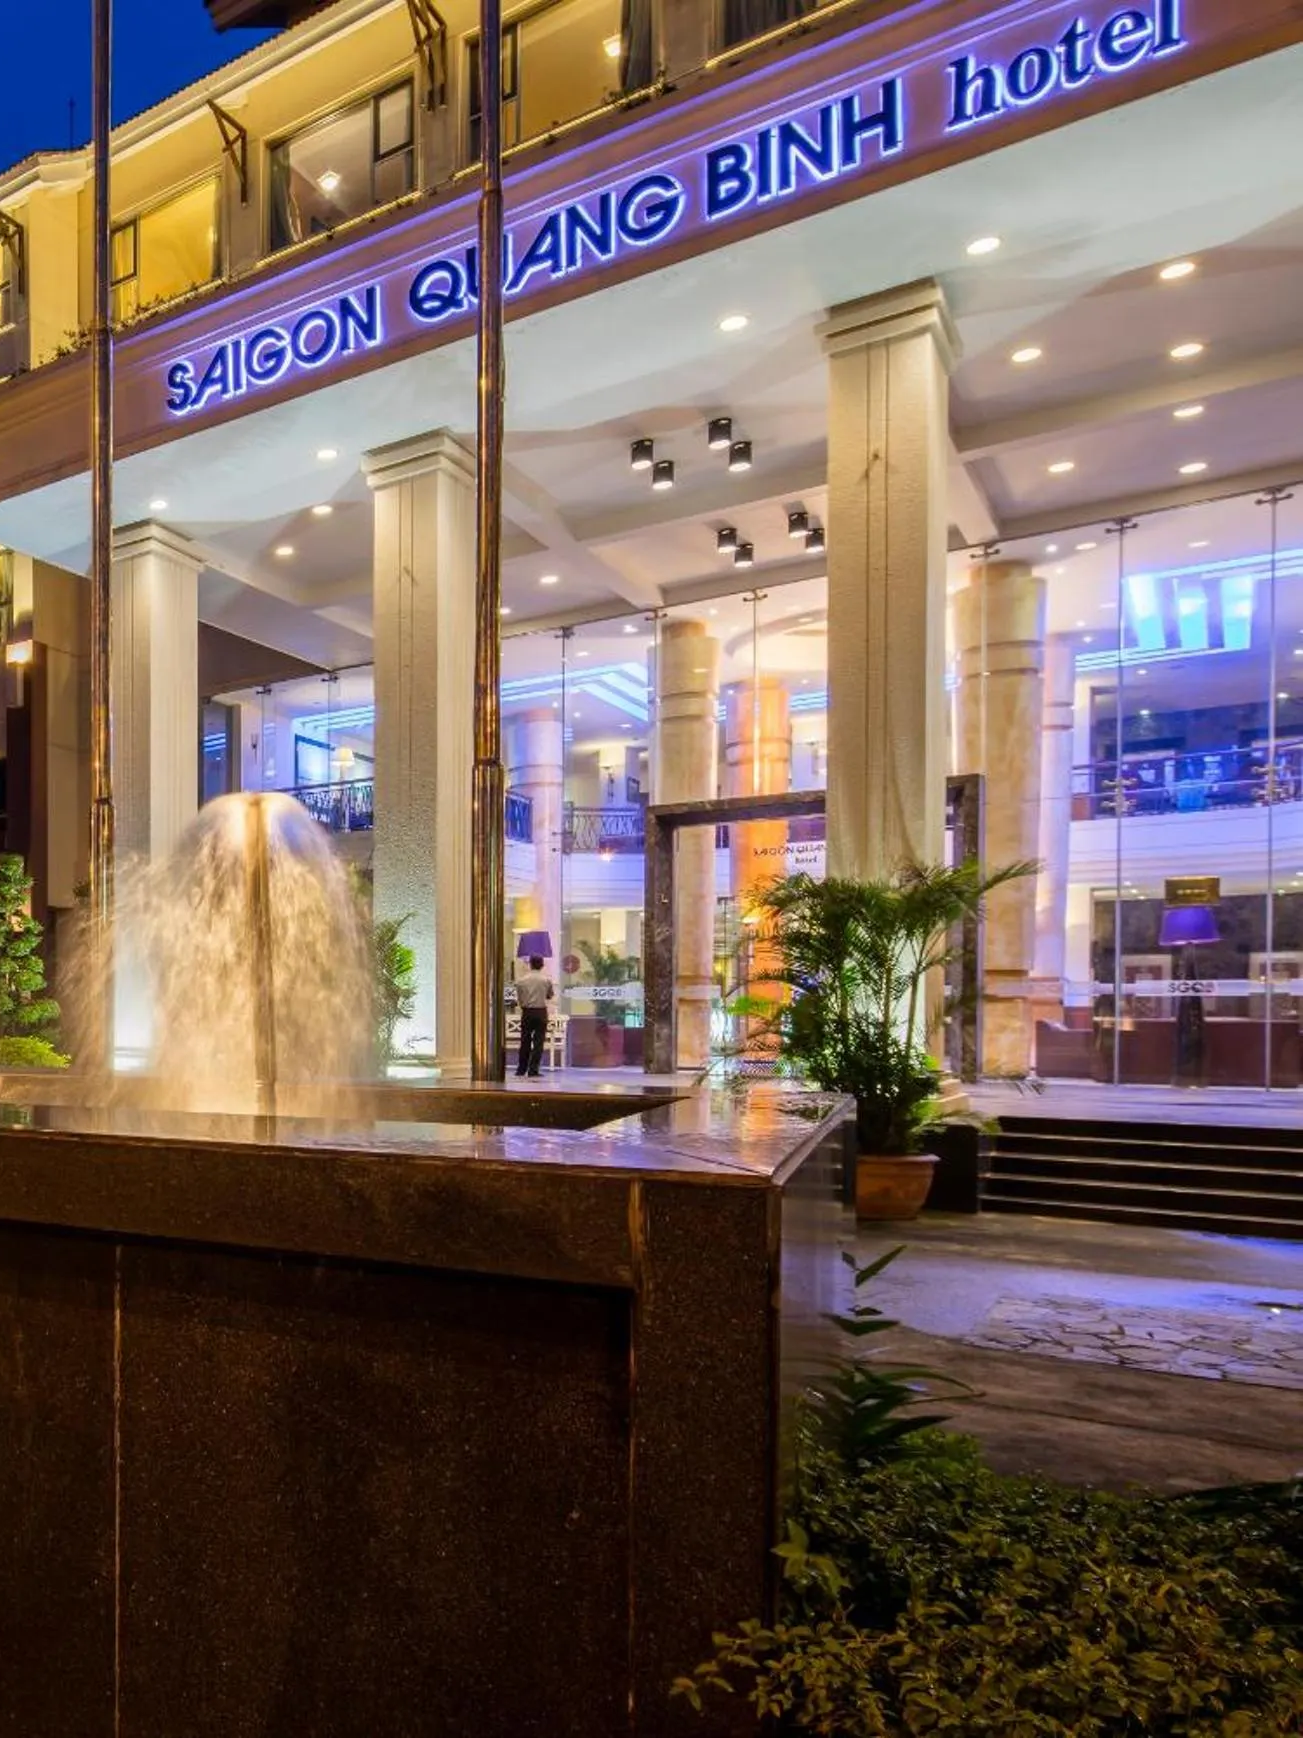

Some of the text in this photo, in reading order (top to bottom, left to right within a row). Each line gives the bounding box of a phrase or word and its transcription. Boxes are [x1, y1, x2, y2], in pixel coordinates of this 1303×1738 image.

[166, 0, 1189, 416] SAIGON QUANG BINH hotel
